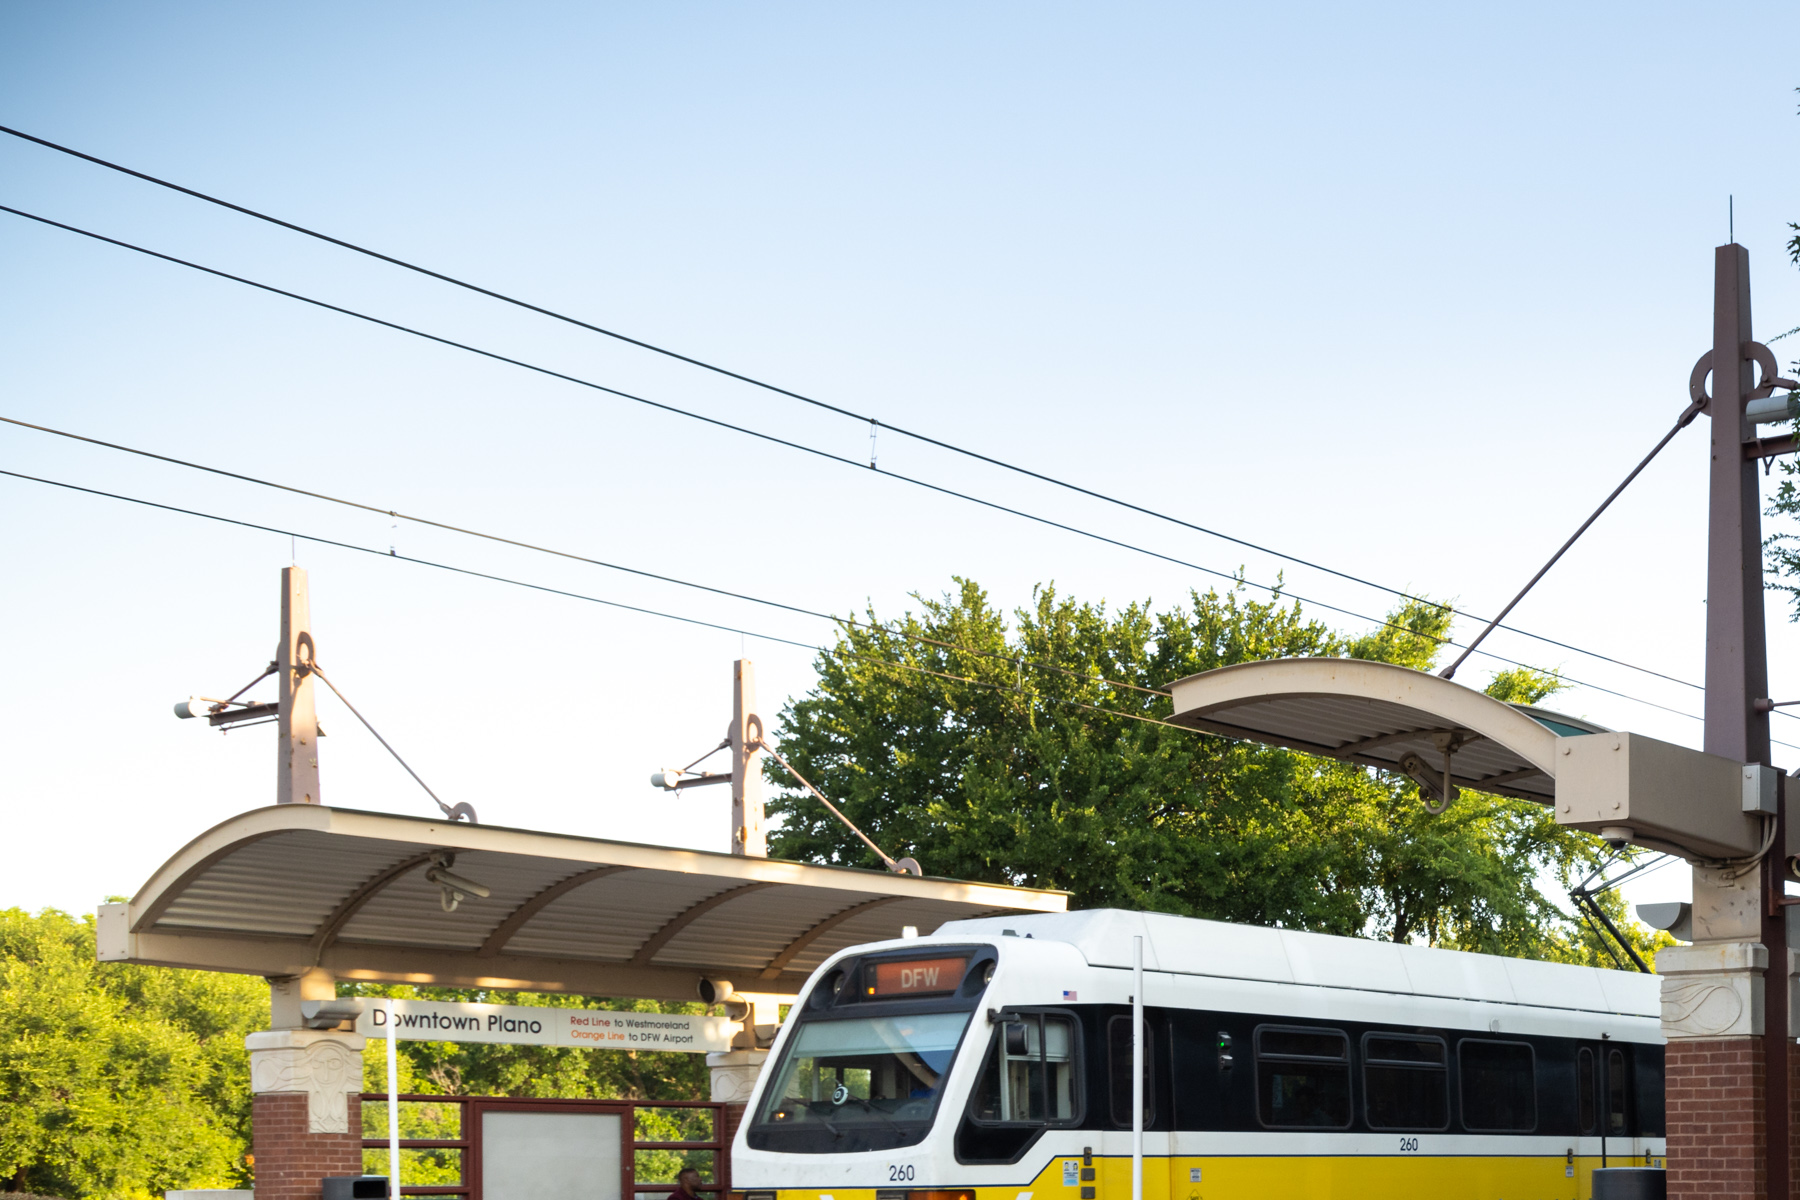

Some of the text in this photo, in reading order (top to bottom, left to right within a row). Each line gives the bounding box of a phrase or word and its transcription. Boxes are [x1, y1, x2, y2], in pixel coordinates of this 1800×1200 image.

[901, 967, 940, 988] DFW
[373, 1008, 542, 1034] Downtown Plano
[570, 1016, 690, 1030] Red Line to Westmoreland
[570, 1030, 694, 1045] Orange Line to DFW Airport
[1400, 1137, 1419, 1151] 260
[889, 1165, 915, 1181] 260
